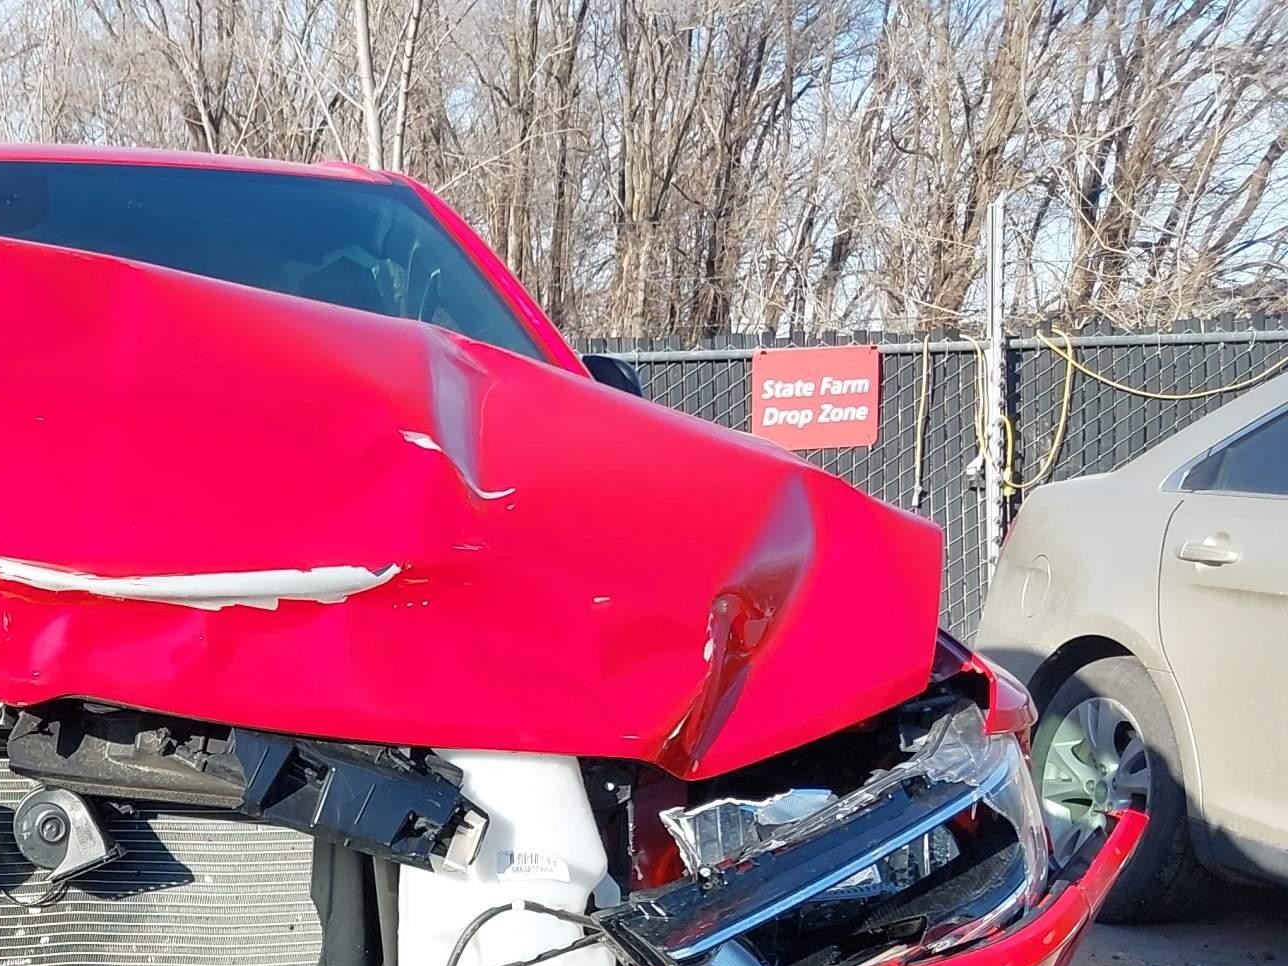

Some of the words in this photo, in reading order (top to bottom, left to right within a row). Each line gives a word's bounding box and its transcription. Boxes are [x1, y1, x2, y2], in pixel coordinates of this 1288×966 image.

[761, 379, 816, 400] State
[819, 376, 870, 396] Farm
[762, 406, 814, 428] Drop
[817, 404, 869, 423] Zone
